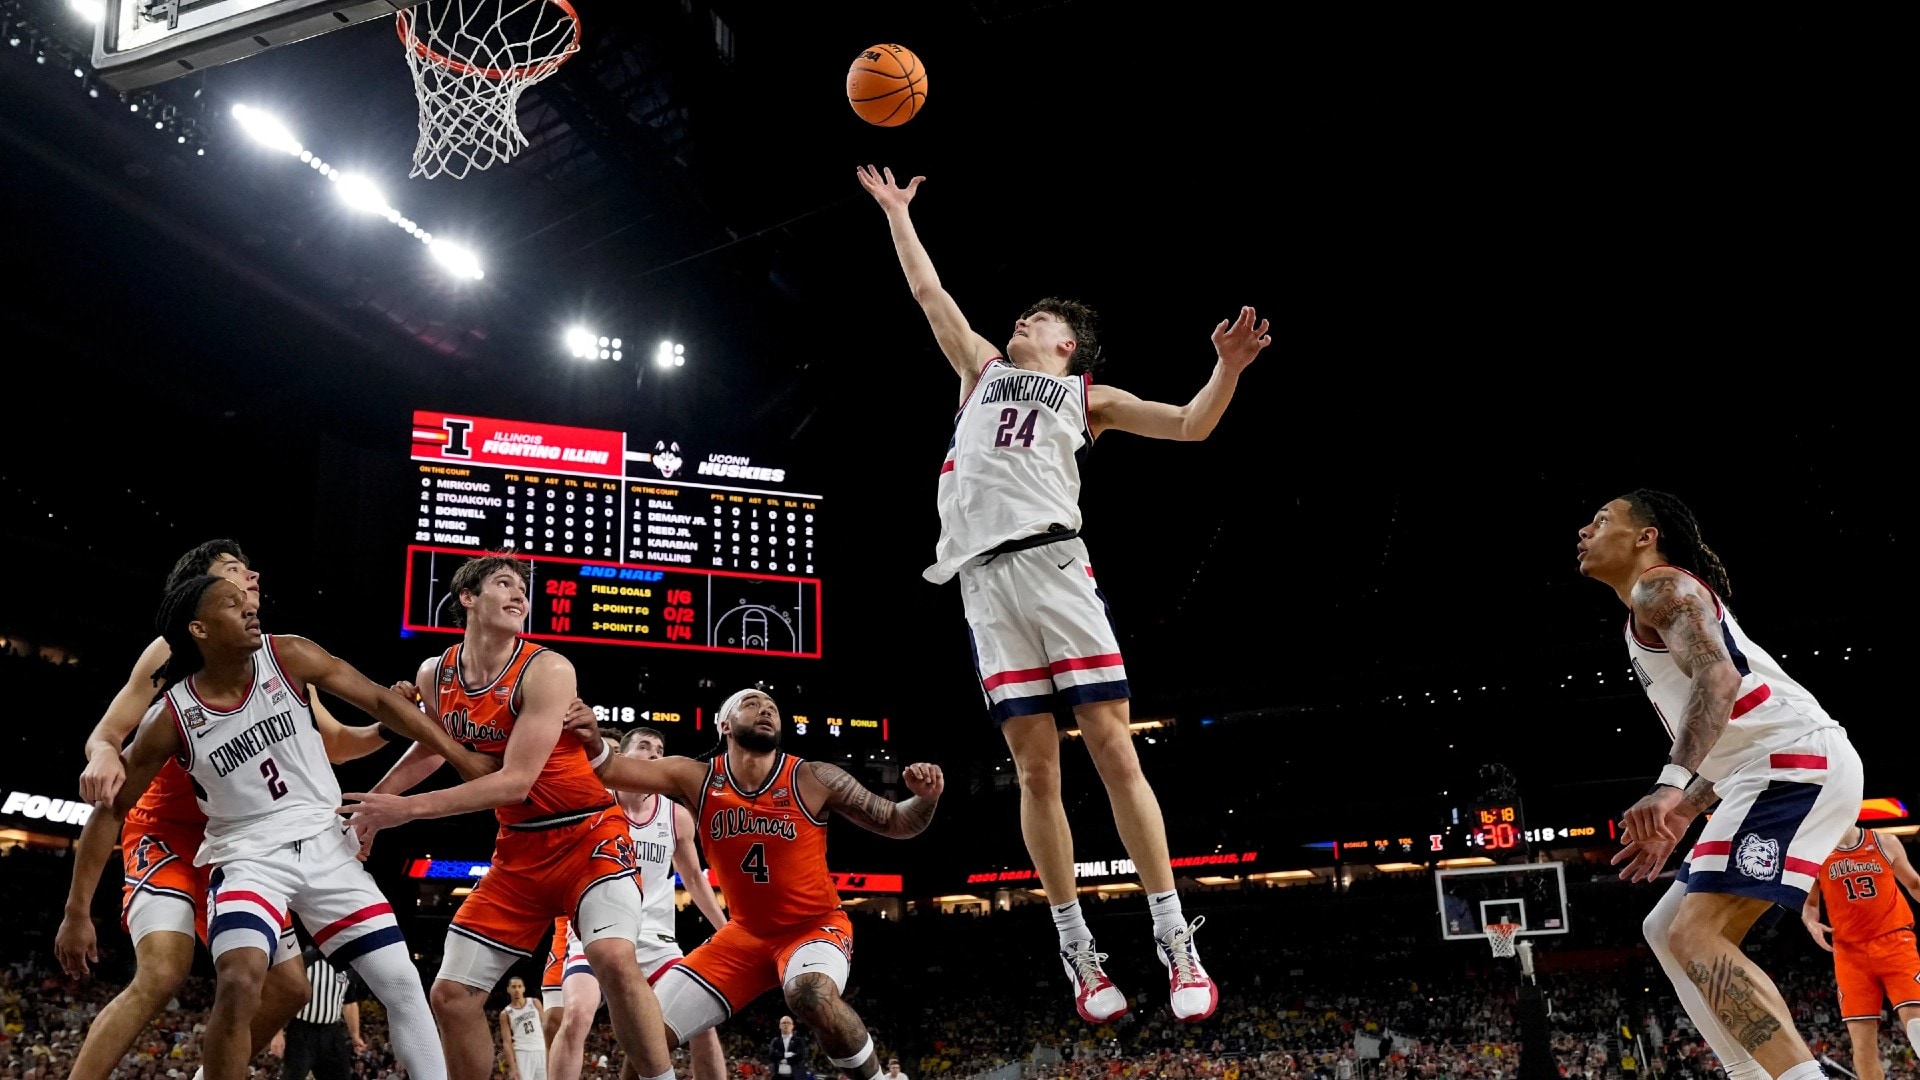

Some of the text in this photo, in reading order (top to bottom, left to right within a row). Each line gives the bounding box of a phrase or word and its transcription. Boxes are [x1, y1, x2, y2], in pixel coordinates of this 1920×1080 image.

[981, 375, 1069, 413] CONNECTICUT
[442, 417, 473, 458] I
[494, 432, 543, 444] ILLINOIS
[995, 407, 1039, 447] 24
[482, 440, 609, 464] FIGHTING ILLINI
[709, 453, 750, 465] UCONN
[431, 466, 446, 474] THE
[446, 468, 470, 476] COURT
[505, 474, 519, 482] PTS
[565, 479, 577, 487] STL
[698, 462, 785, 482] HUSKIES
[422, 478, 612, 503] 0 MIRKOVIC 5 3 0 0 3 3
[656, 488, 679, 496] COURT
[421, 491, 613, 517] 2 STOJAKOVIC 5 2 0 0 0 0
[649, 500, 673, 509] BALL
[714, 506, 721, 514] 3
[732, 508, 740, 516] 0
[769, 511, 777, 519] 0
[787, 513, 795, 521] 0
[805, 514, 813, 522] 0
[420, 505, 428, 513] 4
[436, 506, 486, 519] BOSWELL
[506, 513, 514, 521] 4
[526, 514, 534, 523] 6
[546, 516, 554, 524] 0
[566, 518, 574, 526] 0
[585, 520, 593, 528] 0
[634, 511, 641, 519] 2
[648, 512, 691, 524] DEMARY
[692, 517, 706, 525] JR.
[714, 519, 721, 527] 5
[733, 520, 739, 528] 7
[751, 522, 758, 530] 5
[787, 525, 795, 533] 0
[806, 527, 813, 535] 2
[419, 518, 429, 527] 13
[435, 520, 466, 530] IVISIC
[506, 526, 514, 534] 8
[526, 528, 533, 536] 2
[545, 529, 554, 538] 0
[565, 531, 573, 539] 0
[585, 533, 593, 541] 0
[634, 524, 641, 532] 5
[648, 525, 676, 535] REED
[676, 528, 690, 537] JR.
[732, 533, 740, 541] 6
[751, 535, 759, 543] 0
[769, 536, 777, 544] 0
[787, 538, 795, 546] 0
[806, 540, 813, 548] 2
[416, 532, 611, 556] 23 WAGLER 14 6 2 0 0 2
[634, 537, 640, 545] 11
[648, 538, 698, 550] KARABAN
[714, 544, 720, 552] 7
[732, 546, 739, 554] 2
[751, 548, 758, 556] 2
[630, 550, 643, 559] 24
[648, 552, 691, 563] MULLINS
[713, 557, 722, 565] 12
[751, 560, 758, 569] 0
[769, 562, 777, 570] 0
[788, 564, 795, 572] 0
[806, 565, 813, 573] 2
[580, 566, 663, 581] 2ND HALF
[546, 580, 692, 605] 2/2 FIELD GOALS 1/6
[552, 598, 694, 623] 1/1 2-POINT FG 0/2
[551, 616, 691, 641] 1/1 3-POINT FG 1/4
[652, 712, 680, 722] 2ND
[793, 715, 878, 728] TOL FLS BONUS
[797, 724, 840, 737] 3 4
[209, 710, 296, 777] CONNECTICUT
[259, 757, 288, 801] 2
[1, 791, 94, 825] FOUR
[1481, 807, 1514, 823] 16:18
[710, 806, 797, 840] Illinois
[1569, 827, 1595, 837] 2ND
[1343, 840, 1368, 849] BONUS
[1483, 824, 1514, 850] 30
[633, 840, 666, 864] CTICUT
[740, 843, 769, 883] 4
[1242, 852, 1258, 861] IN
[1074, 859, 1138, 878] FINAL FOU
[1829, 858, 1882, 880] Illinois
[1843, 876, 1877, 901] 13
[523, 1021, 535, 1034] 23
